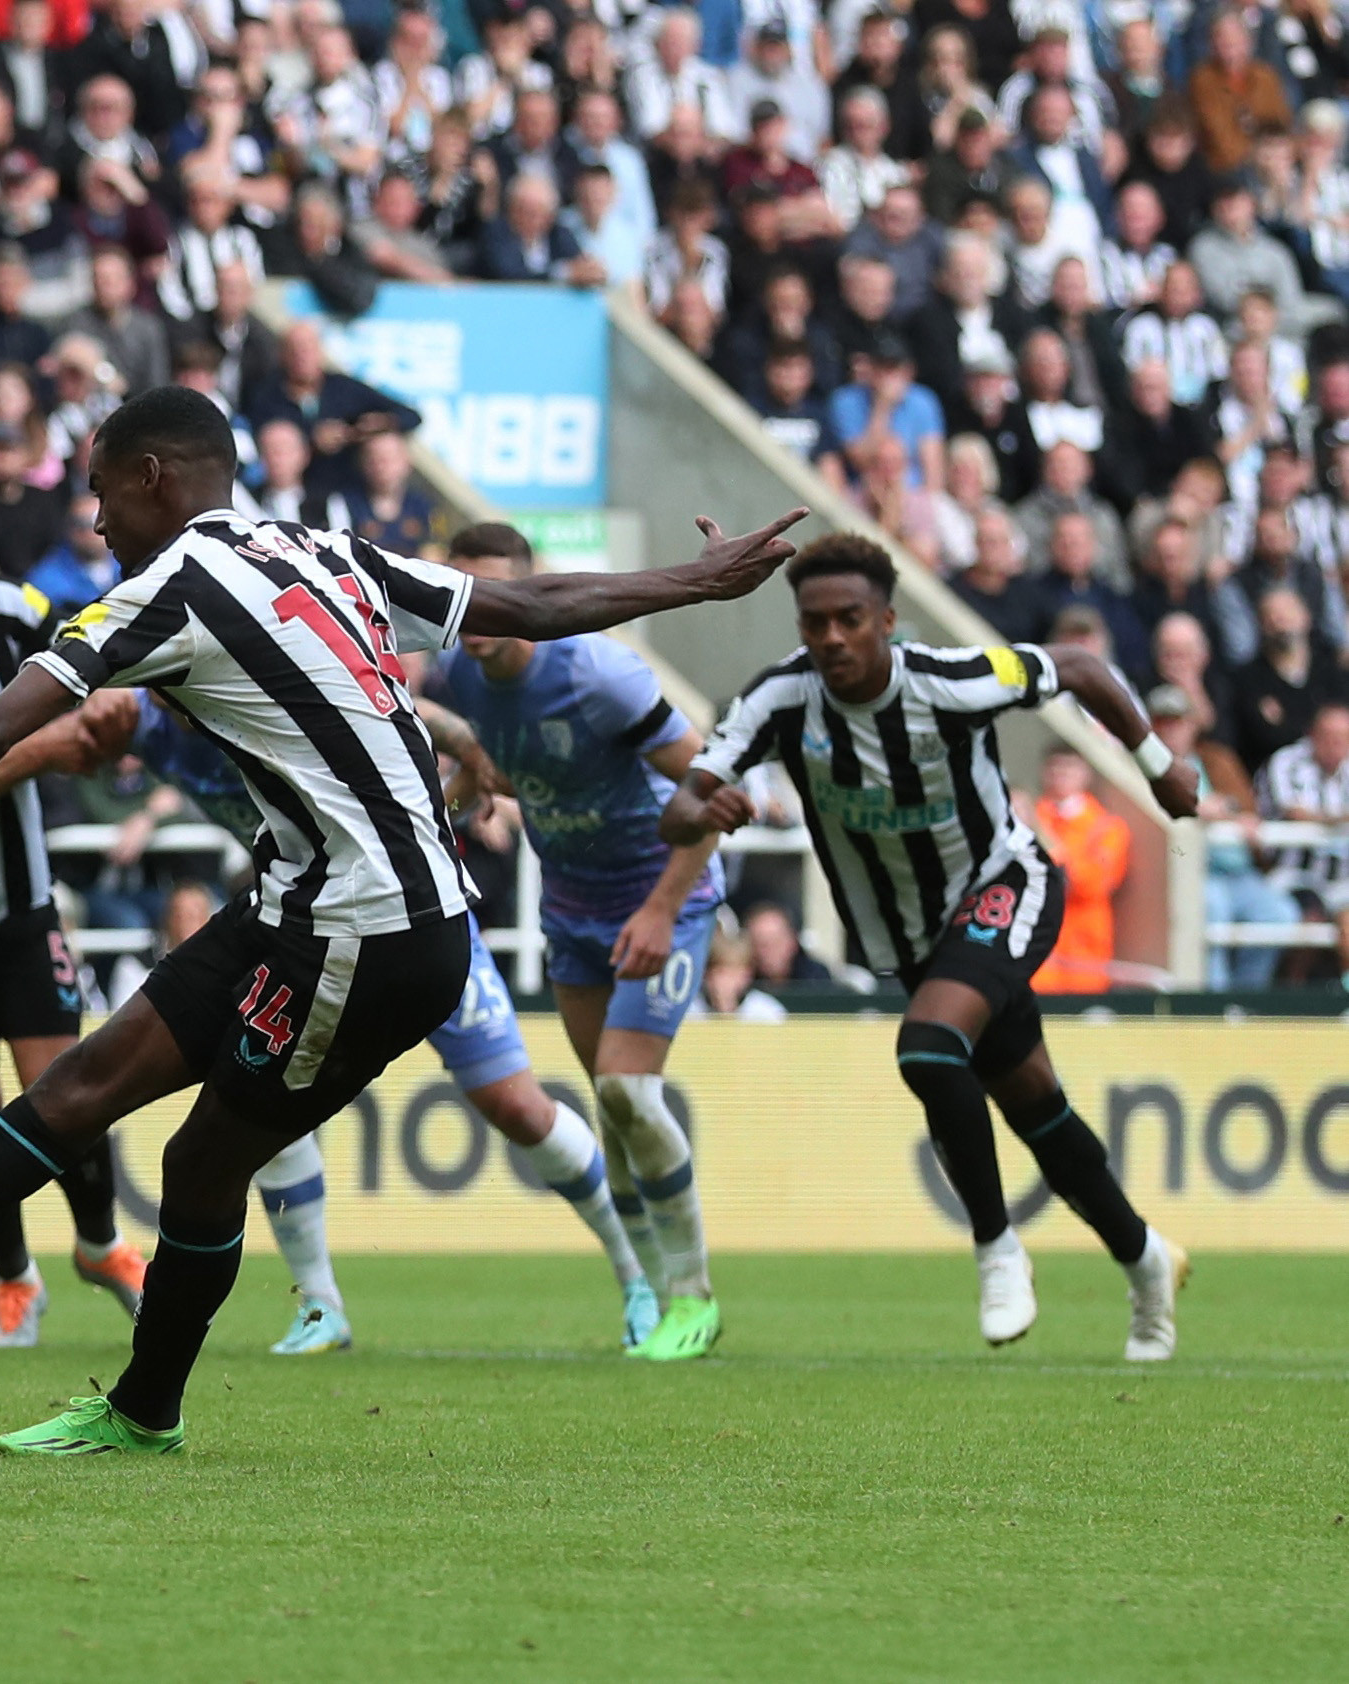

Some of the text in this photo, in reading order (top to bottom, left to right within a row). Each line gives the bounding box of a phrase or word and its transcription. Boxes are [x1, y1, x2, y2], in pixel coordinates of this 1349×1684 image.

[234, 533, 320, 562] ISAK
[270, 573, 410, 716] 14
[47, 930, 75, 985] 5
[238, 964, 294, 1055] 14
[460, 967, 512, 1028] 25
